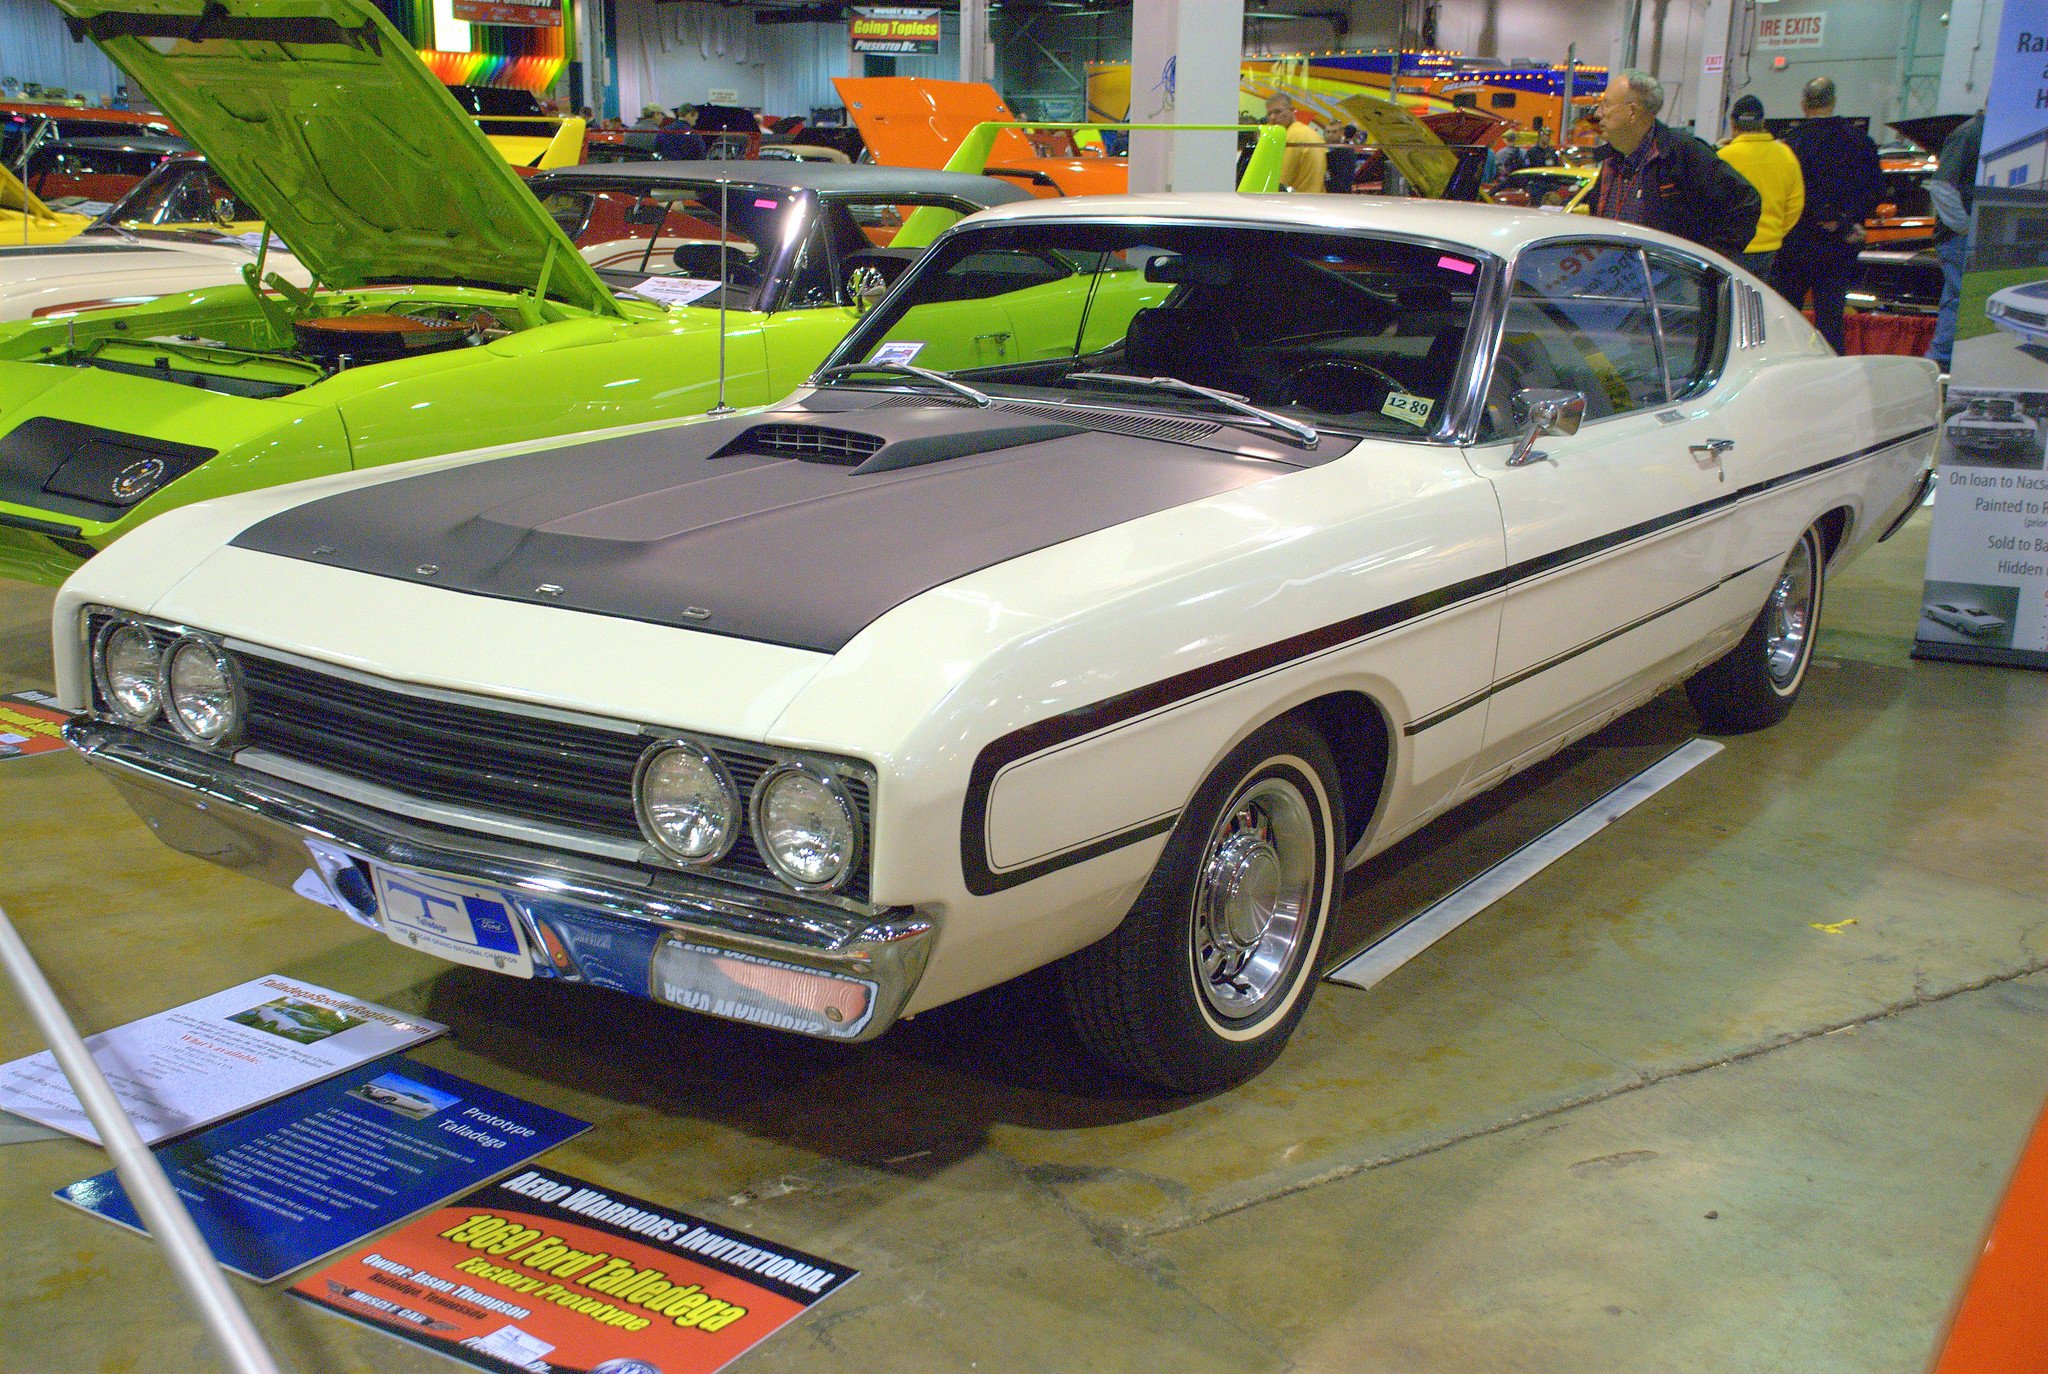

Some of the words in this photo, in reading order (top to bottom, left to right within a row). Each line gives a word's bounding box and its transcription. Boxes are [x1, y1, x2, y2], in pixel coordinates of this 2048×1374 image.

[853, 19, 889, 36] Going
[890, 20, 938, 36] Topless
[1784, 16, 1821, 36] EXITS
[1705, 56, 1723, 65] EXIT
[1388, 396, 1407, 410] 12
[1409, 400, 1428, 416] 89
[1949, 471, 1967, 486] On
[1969, 472, 1997, 487] loan
[2000, 475, 2014, 488] to
[1975, 497, 2024, 513] Painted
[2026, 502, 2040, 514] to
[1988, 535, 2015, 550] Sold
[2018, 539, 2031, 551] to
[1998, 560, 2043, 576] Hidden
[385, 879, 460, 920] T
[480, 917, 502, 931] Ford
[259, 978, 432, 1036] TalladegaSpoilerRegistryom
[438, 1118, 507, 1149] Talladega
[462, 1107, 536, 1138] Prototype
[499, 1170, 567, 1203] AERO
[557, 1187, 689, 1243] WARRIORS
[672, 1225, 837, 1295] INVITATIONAL
[360, 1253, 414, 1280] Owner:
[407, 1270, 457, 1294] Jason
[450, 1283, 533, 1321] Thompson
[440, 1213, 542, 1257] 1969
[512, 1233, 611, 1280] Ford
[574, 1256, 750, 1333] Talledega
[346, 1289, 401, 1315] MUSCLE
[397, 1307, 430, 1325] CAR
[422, 1289, 489, 1321] Tennessee
[453, 1256, 548, 1295] Factory
[532, 1276, 654, 1333] Prototype
